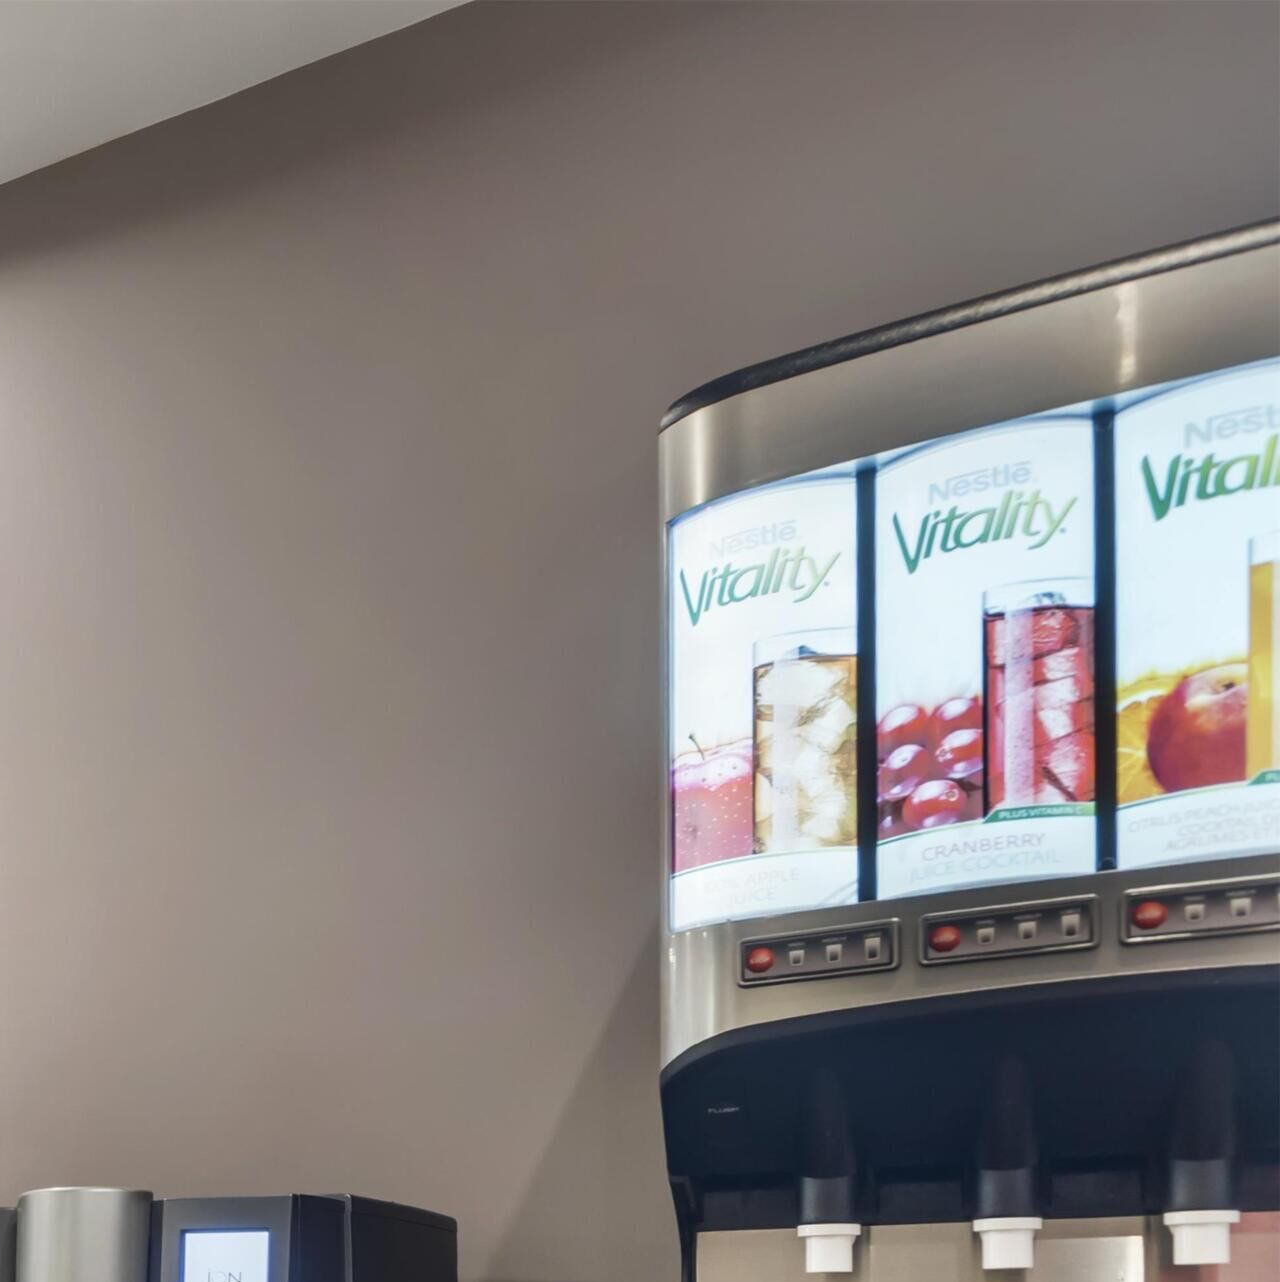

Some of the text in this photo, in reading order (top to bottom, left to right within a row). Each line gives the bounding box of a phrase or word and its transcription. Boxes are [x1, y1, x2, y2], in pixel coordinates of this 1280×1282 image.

[892, 489, 1079, 576] Vitality
[680, 546, 842, 627] Vitality
[921, 832, 1047, 862] CRANBERRY
[958, 848, 1064, 873] COCKTAIL
